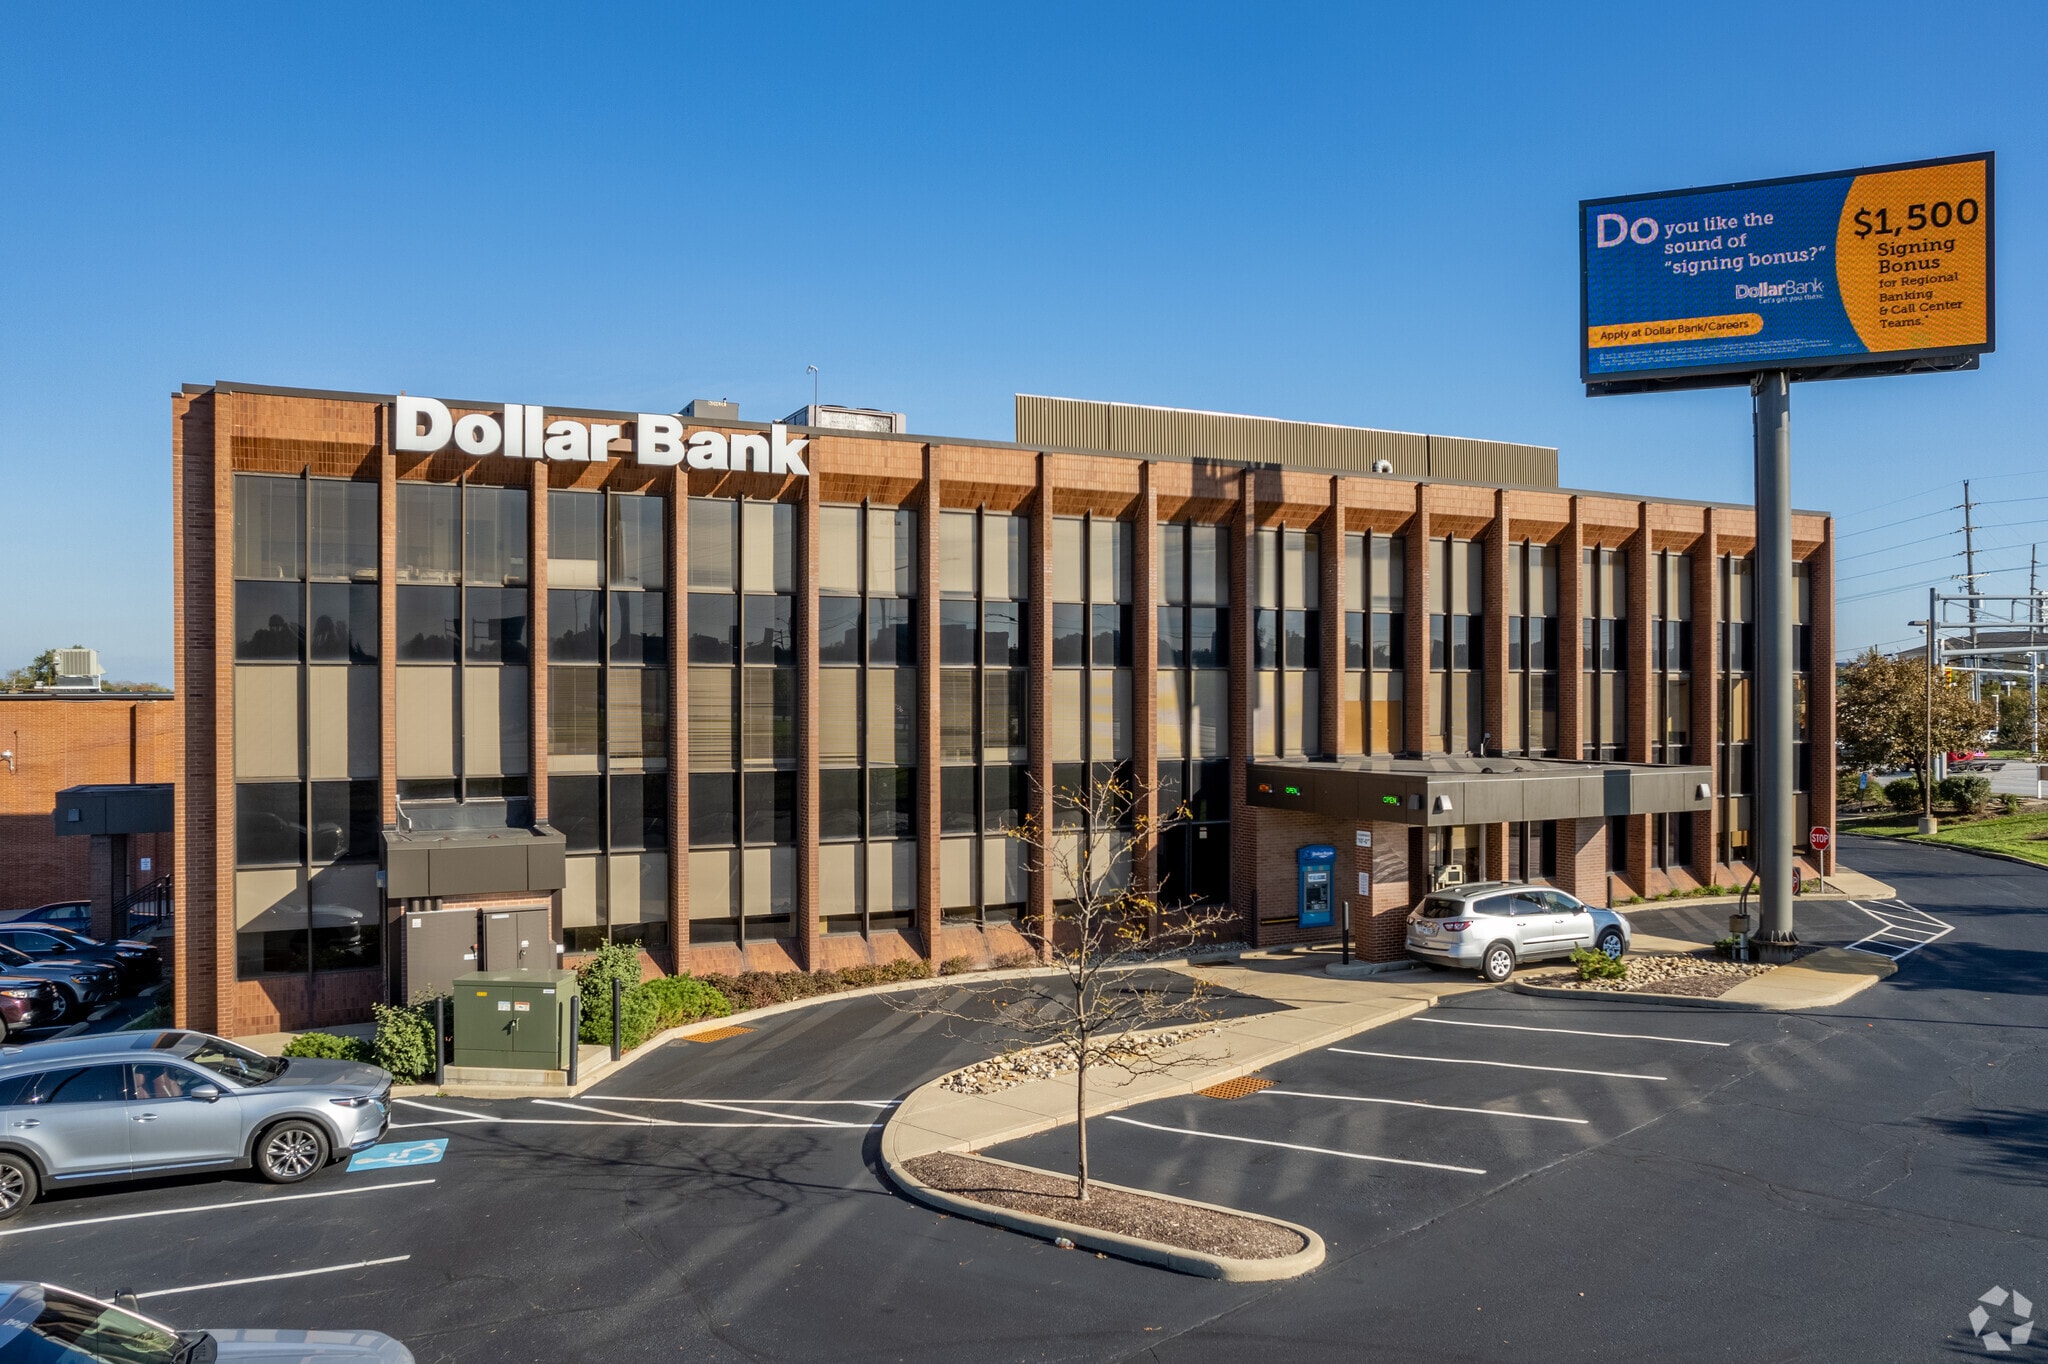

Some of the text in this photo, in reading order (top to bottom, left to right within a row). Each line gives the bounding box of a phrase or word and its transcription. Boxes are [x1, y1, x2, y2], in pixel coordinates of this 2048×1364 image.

[1664, 221, 1699, 239] you
[1703, 216, 1738, 231] like
[1743, 212, 1774, 227] the
[1853, 198, 1979, 239] $1,500
[1664, 233, 1747, 254] sound of
[1877, 238, 1955, 257] Signing
[1878, 258, 1940, 274] Bonus
[1879, 272, 1959, 288] for Regional
[1879, 290, 1933, 302] Banking
[1879, 300, 1963, 315] & Call Center
[1600, 329, 1629, 341] Apply
[1631, 328, 1641, 337] at
[396, 395, 810, 475] Dollar Bank
[1382, 796, 1397, 804] OPEN
[1811, 834, 1829, 843] STOP
